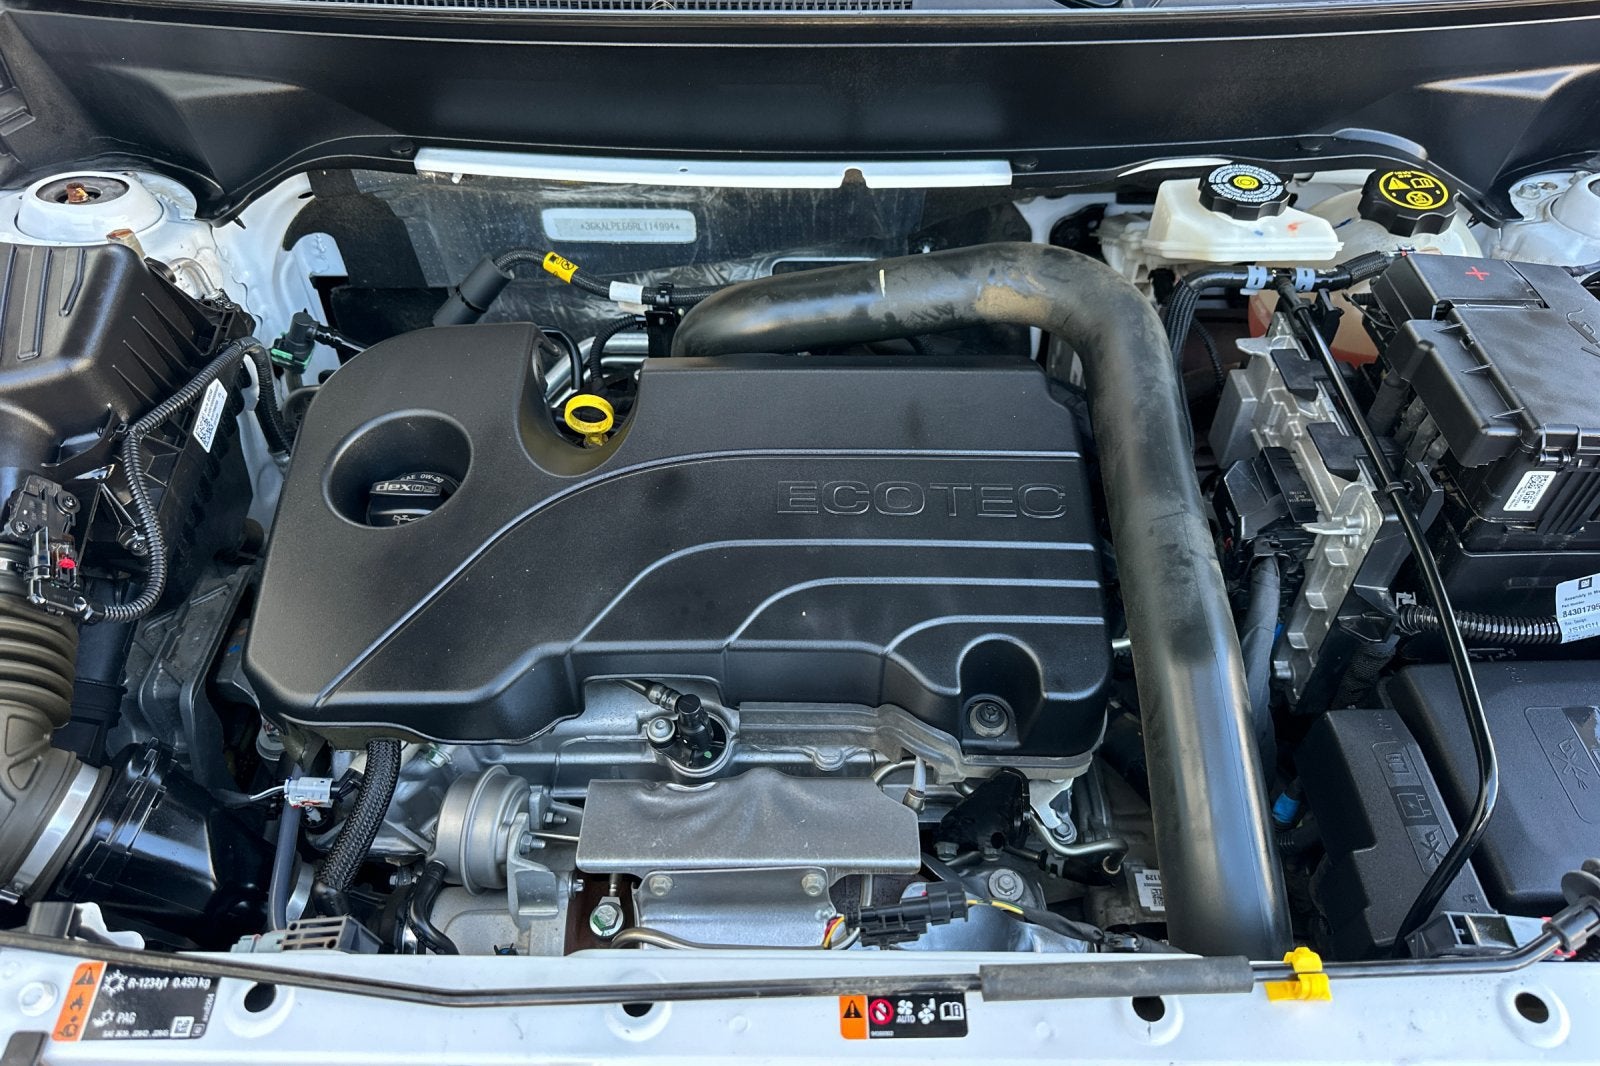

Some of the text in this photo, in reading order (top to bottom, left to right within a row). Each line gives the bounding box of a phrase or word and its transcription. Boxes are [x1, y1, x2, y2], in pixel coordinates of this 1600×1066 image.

[777, 480, 1067, 519] ECOTEC
[127, 977, 211, 991] R-1234yf 0.450 kg
[116, 1012, 137, 1025] PAG
[896, 1014, 916, 1024] AUTO
